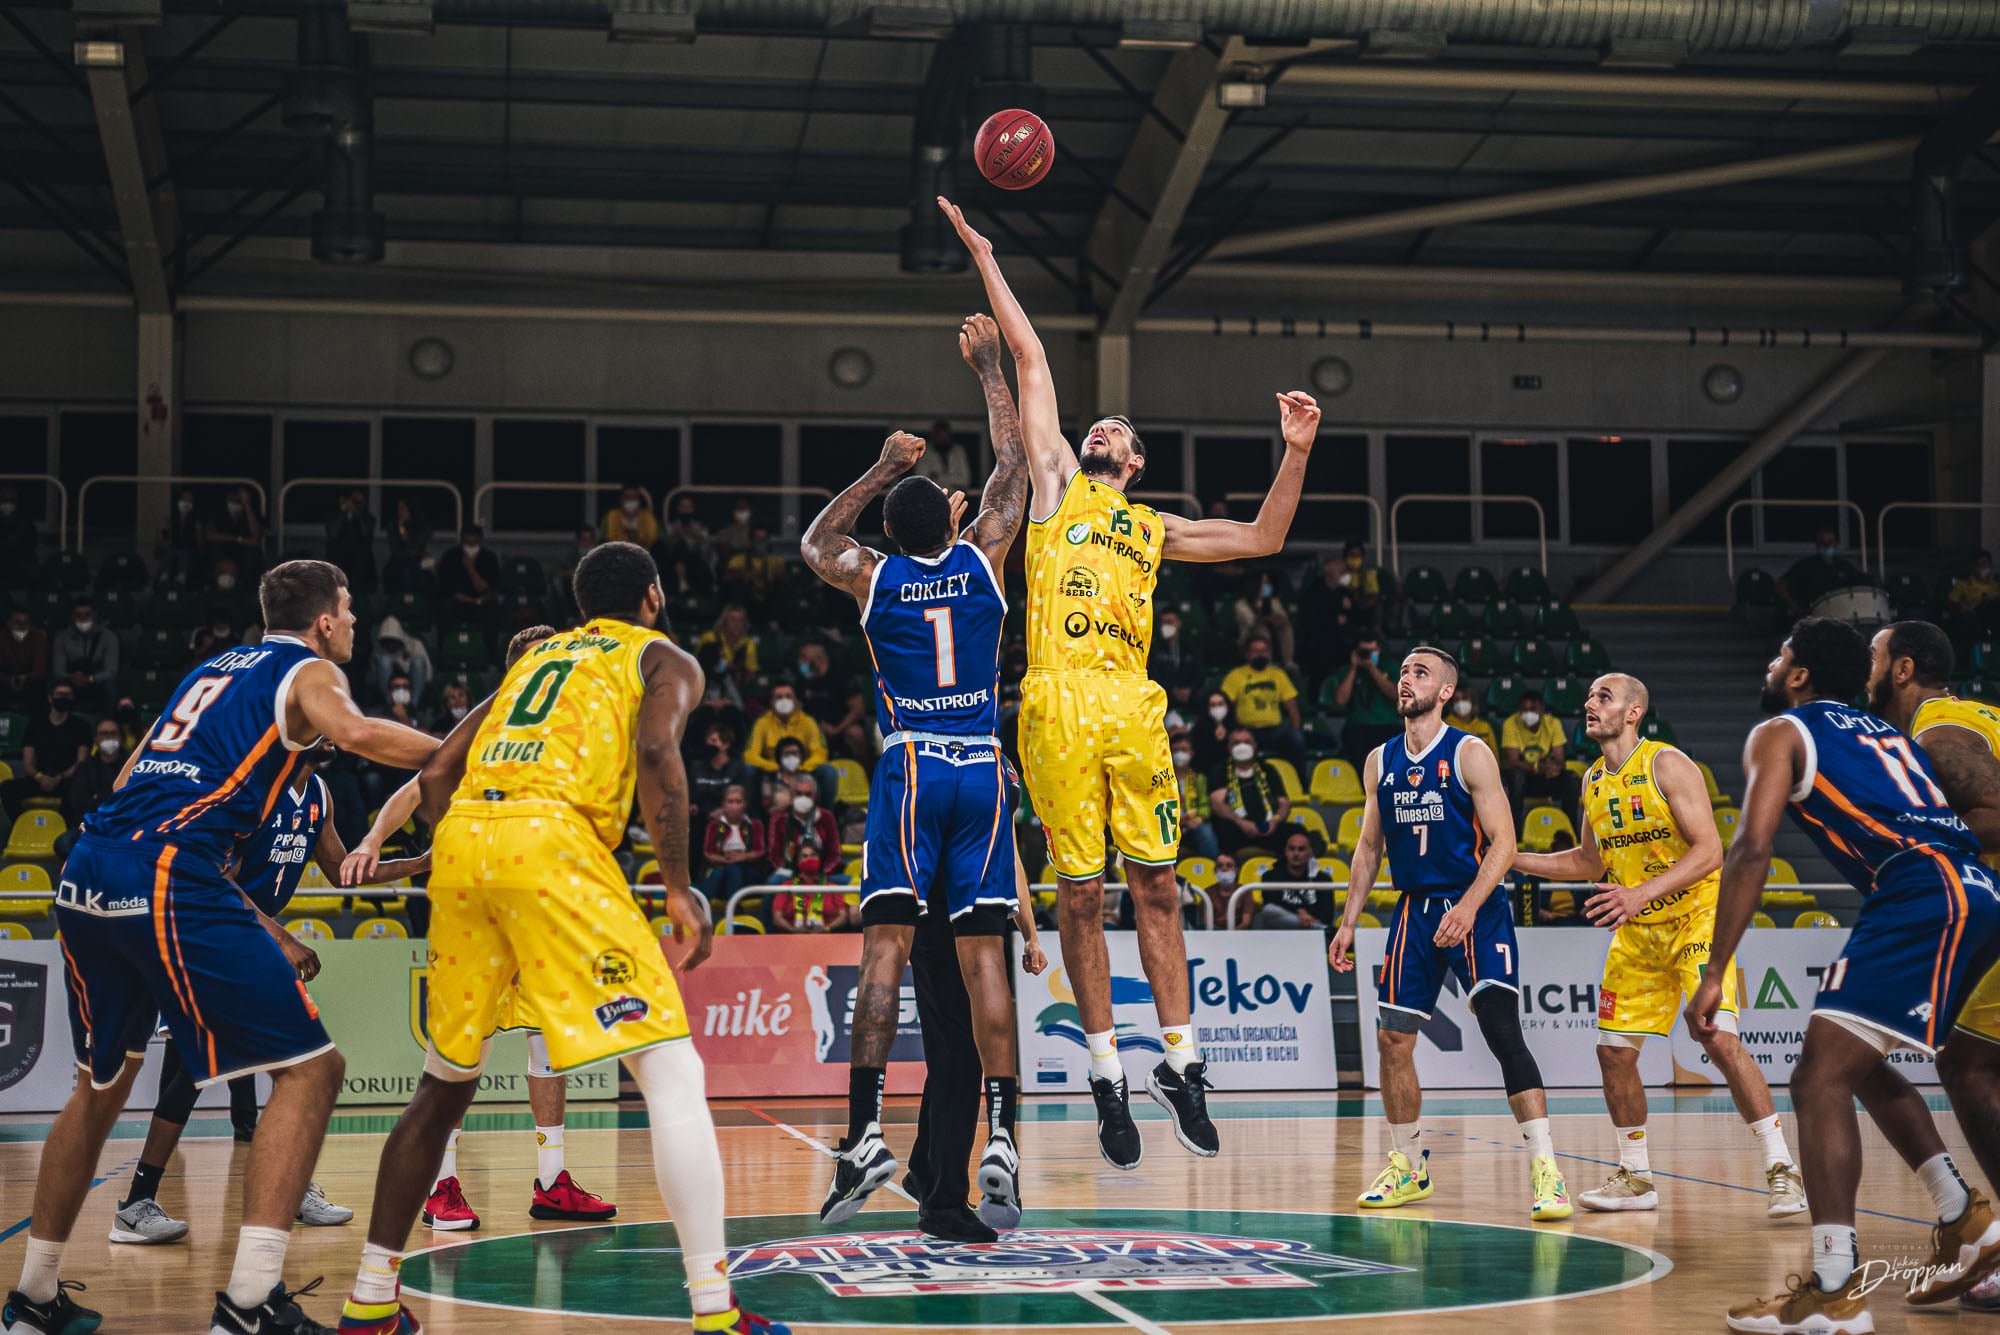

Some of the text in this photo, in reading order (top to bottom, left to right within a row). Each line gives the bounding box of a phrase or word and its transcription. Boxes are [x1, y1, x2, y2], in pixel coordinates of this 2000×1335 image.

[991, 122, 1035, 169] SPALDING
[901, 572, 971, 603] COKLEY
[924, 606, 957, 688] 1
[504, 658, 579, 729] 0
[151, 674, 233, 751] 9
[480, 740, 546, 763] LEVICE
[968, 750, 995, 759] móda
[1393, 791, 1418, 805] PRP
[1395, 807, 1431, 823] finesa
[1608, 796, 1624, 830] 5
[1412, 824, 1428, 857] 7
[1600, 827, 1672, 850] INTERAGROS
[107, 896, 148, 910] móda
[1635, 889, 1691, 918] EOLIA
[1496, 943, 1512, 976] 7
[1187, 957, 1314, 1015] Tekov
[703, 988, 792, 1038] niké
[1566, 1020, 1598, 1029] VINE
[1243, 1022, 1299, 1042] ORGANIZÁCIA
[1265, 1046, 1299, 1062] RUCHU
[834, 1276, 1314, 1296] LEVICE
